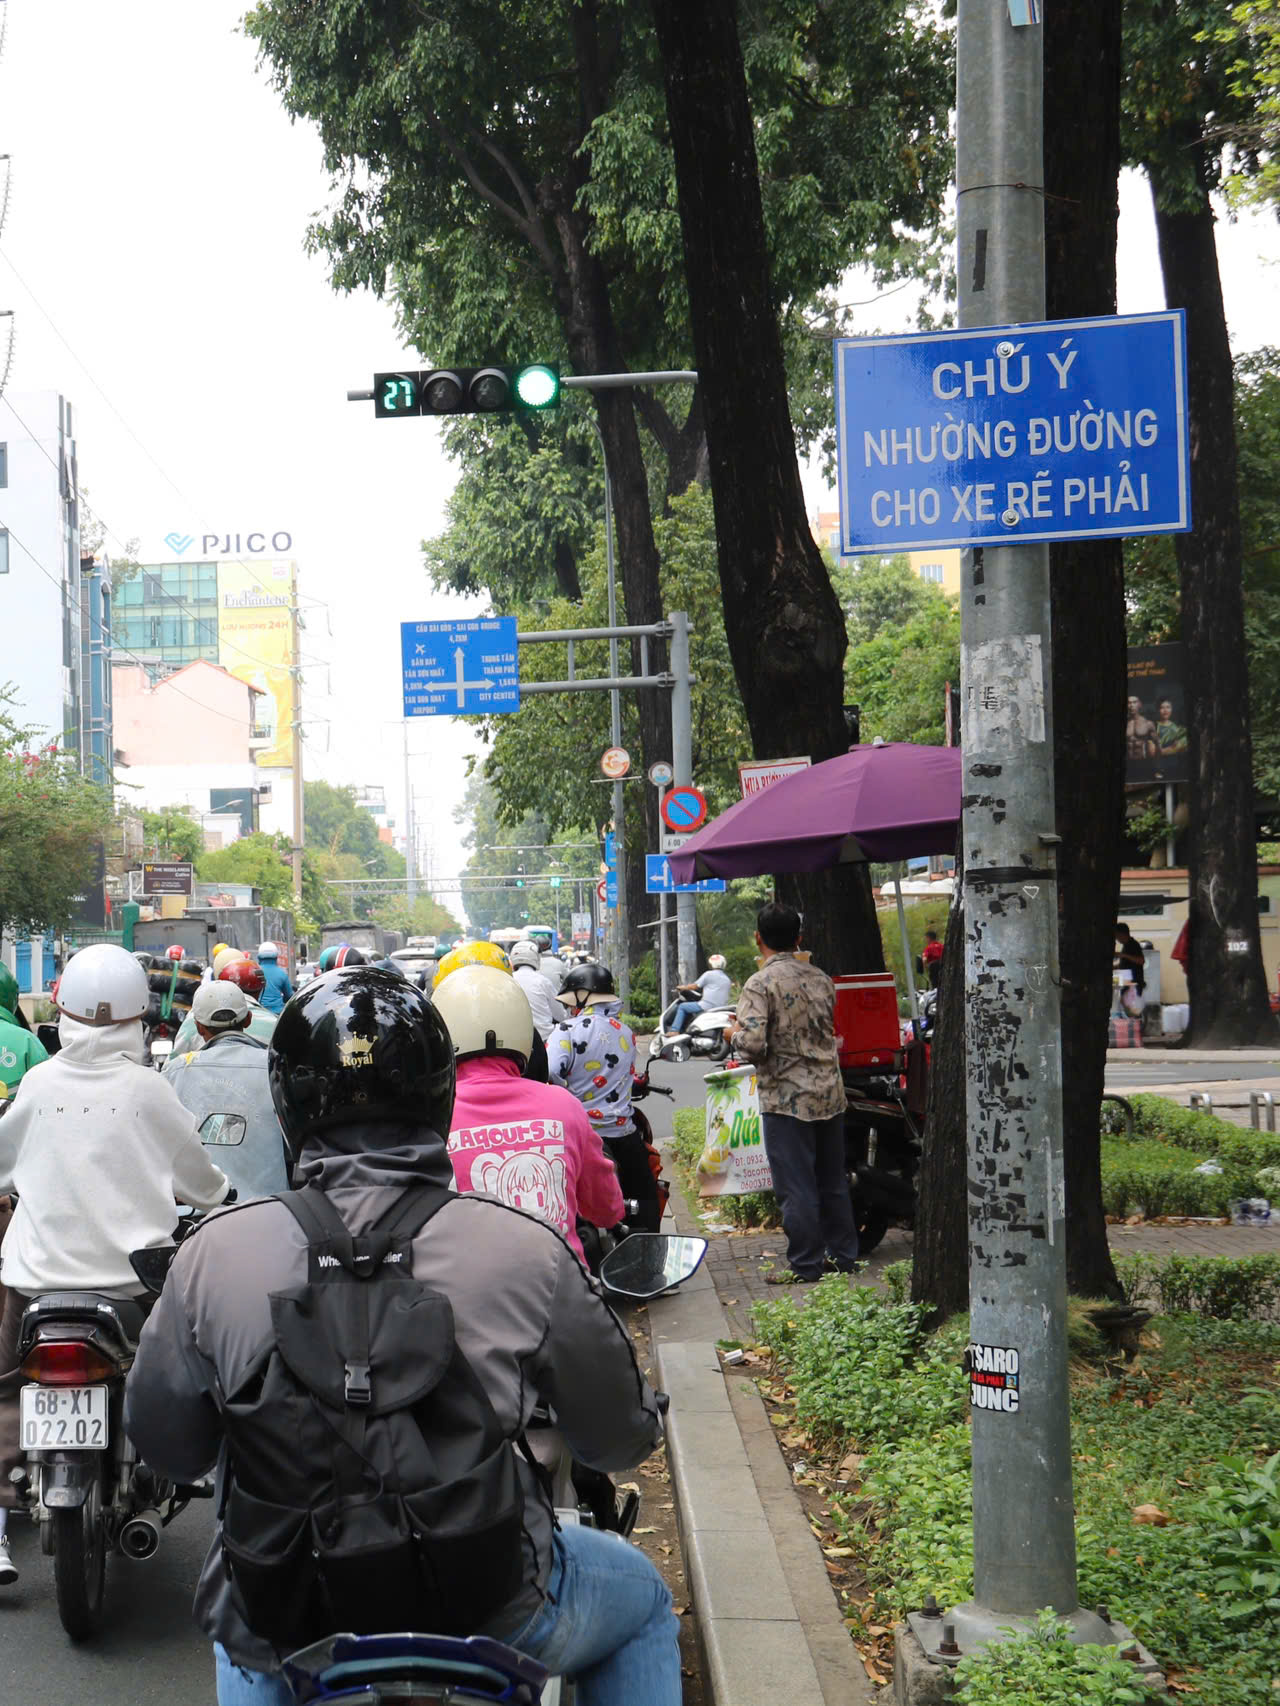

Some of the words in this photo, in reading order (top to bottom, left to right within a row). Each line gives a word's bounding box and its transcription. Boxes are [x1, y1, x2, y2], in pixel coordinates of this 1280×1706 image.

[932, 343, 1030, 400] CHÚ
[1047, 339, 1079, 390] Ý
[864, 412, 1017, 468] NHƯỜNG
[1027, 400, 1158, 456] ĐƯỜNG
[871, 487, 941, 528] CHO
[951, 483, 996, 523] XE
[1006, 469, 1053, 520] RẼ
[1063, 460, 1149, 517] PHẢI
[202, 531, 292, 554] PJICO
[342, 1053, 374, 1069] Royal
[34, 1389, 92, 1415] 68-X1
[25, 1419, 103, 1446] 022.02
